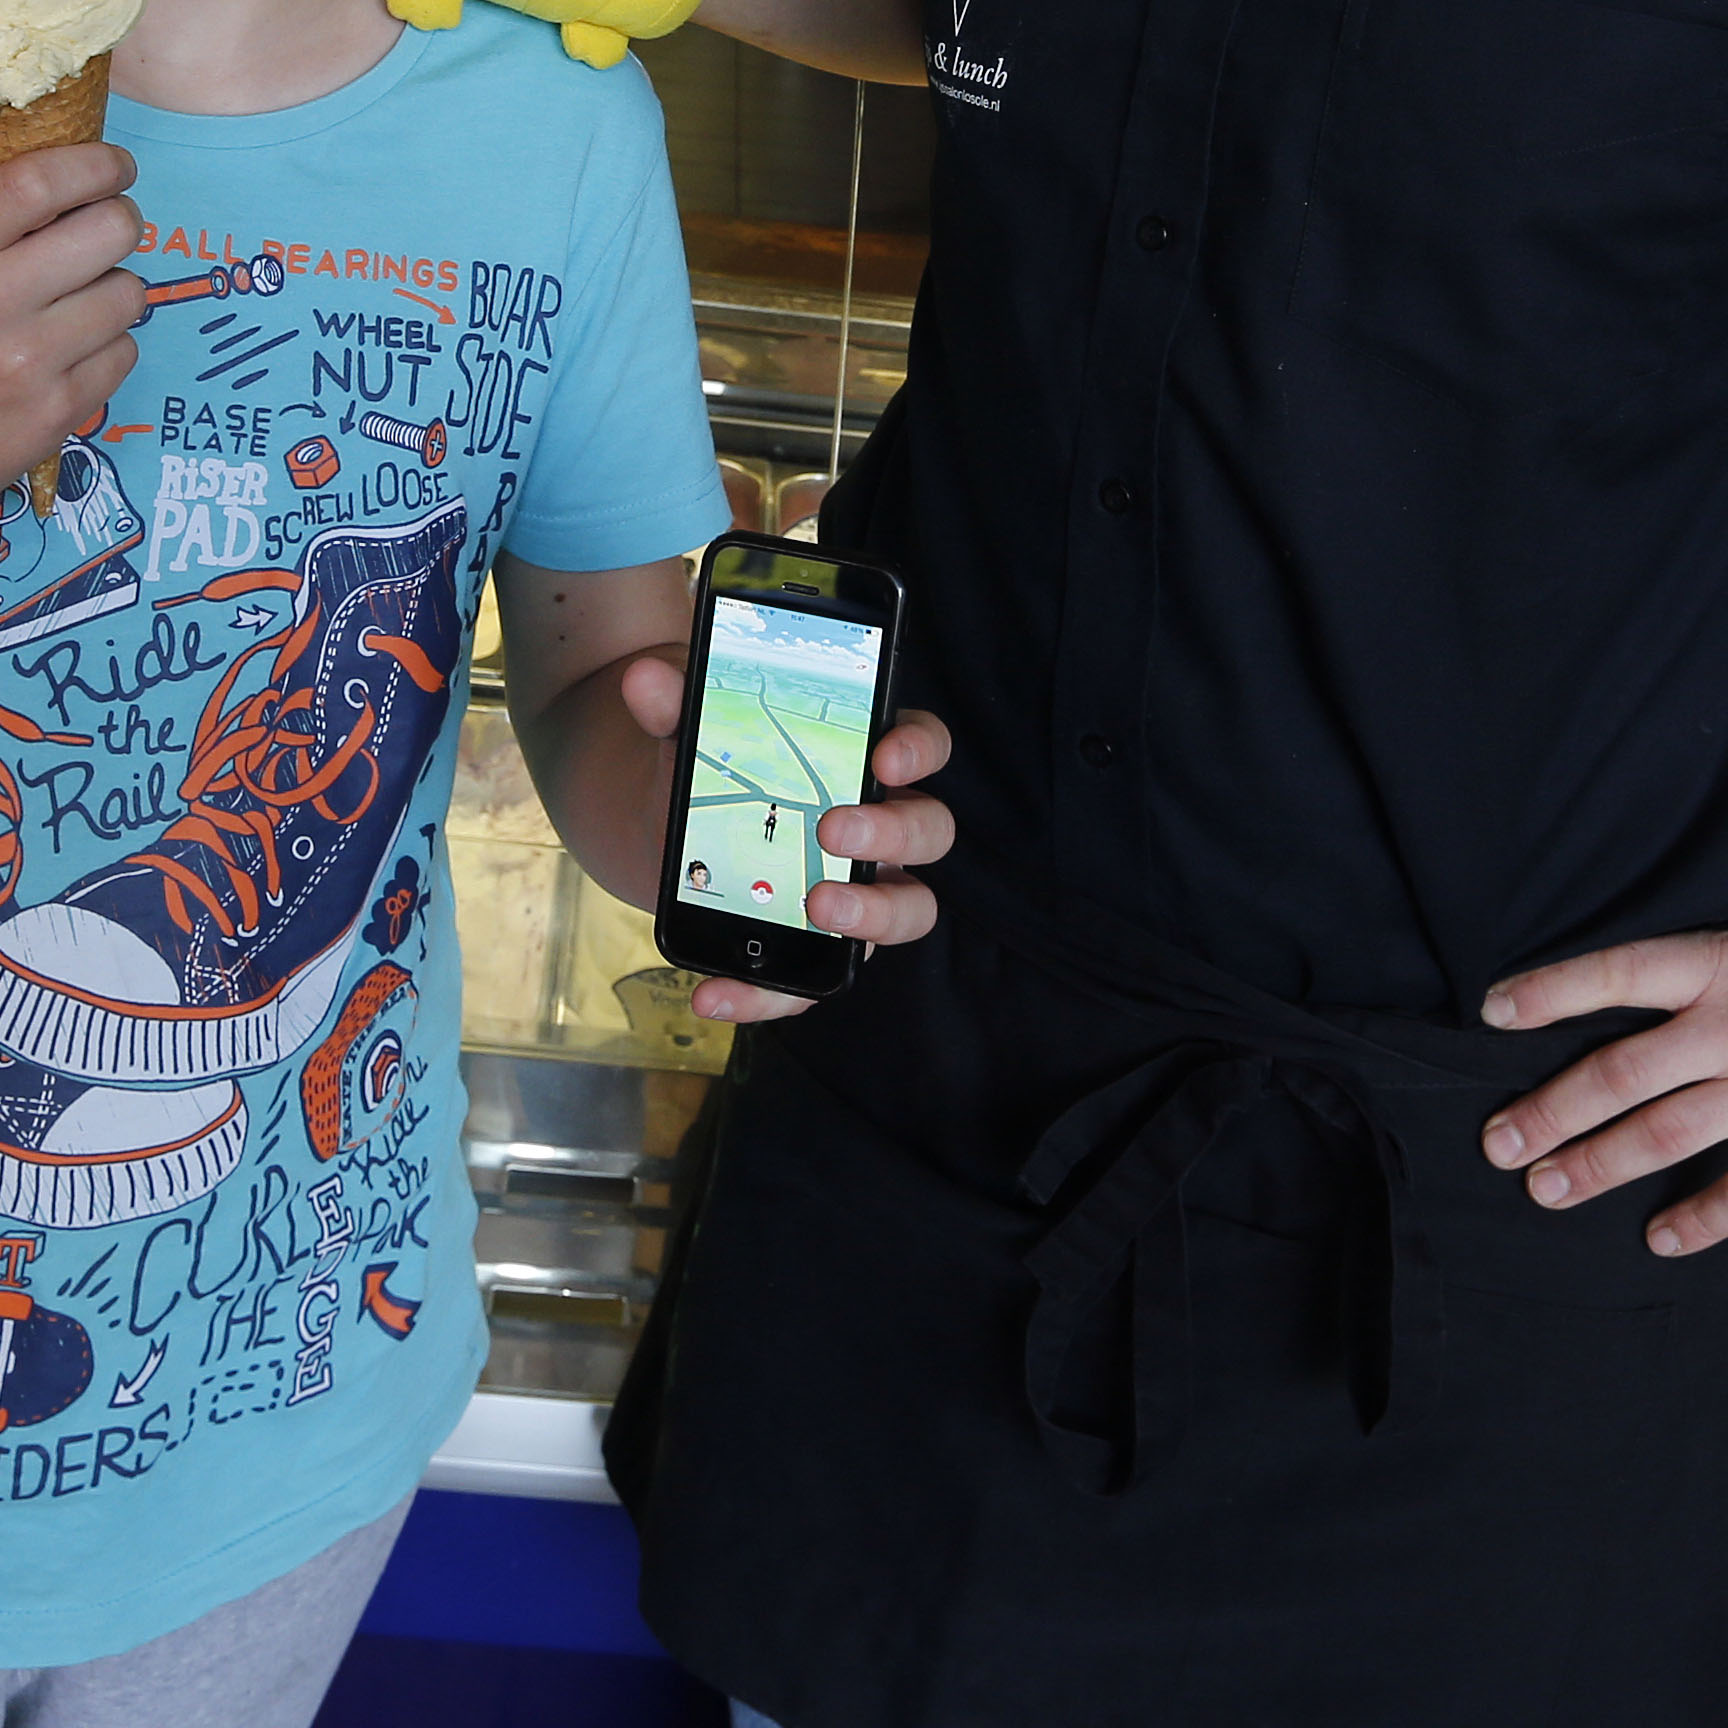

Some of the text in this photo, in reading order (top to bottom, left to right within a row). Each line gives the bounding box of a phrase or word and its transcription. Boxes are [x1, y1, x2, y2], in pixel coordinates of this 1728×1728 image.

[934, 42, 947, 72] &
[952, 46, 1008, 89] lunch
[135, 221, 460, 292] BALL BEARINGS
[312, 308, 442, 353] WHEEL
[312, 348, 432, 406] NUT
[160, 425, 267, 457] PLATE
[164, 396, 272, 436] BASE
[143, 498, 260, 583] PAD
[264, 462, 449, 561] SCREW LOOSE
[12, 613, 227, 727] Ride
[99, 705, 187, 755] the
[16, 758, 182, 853] Rail
[199, 1274, 296, 1367] THE
[285, 1173, 356, 1407] EDGE
